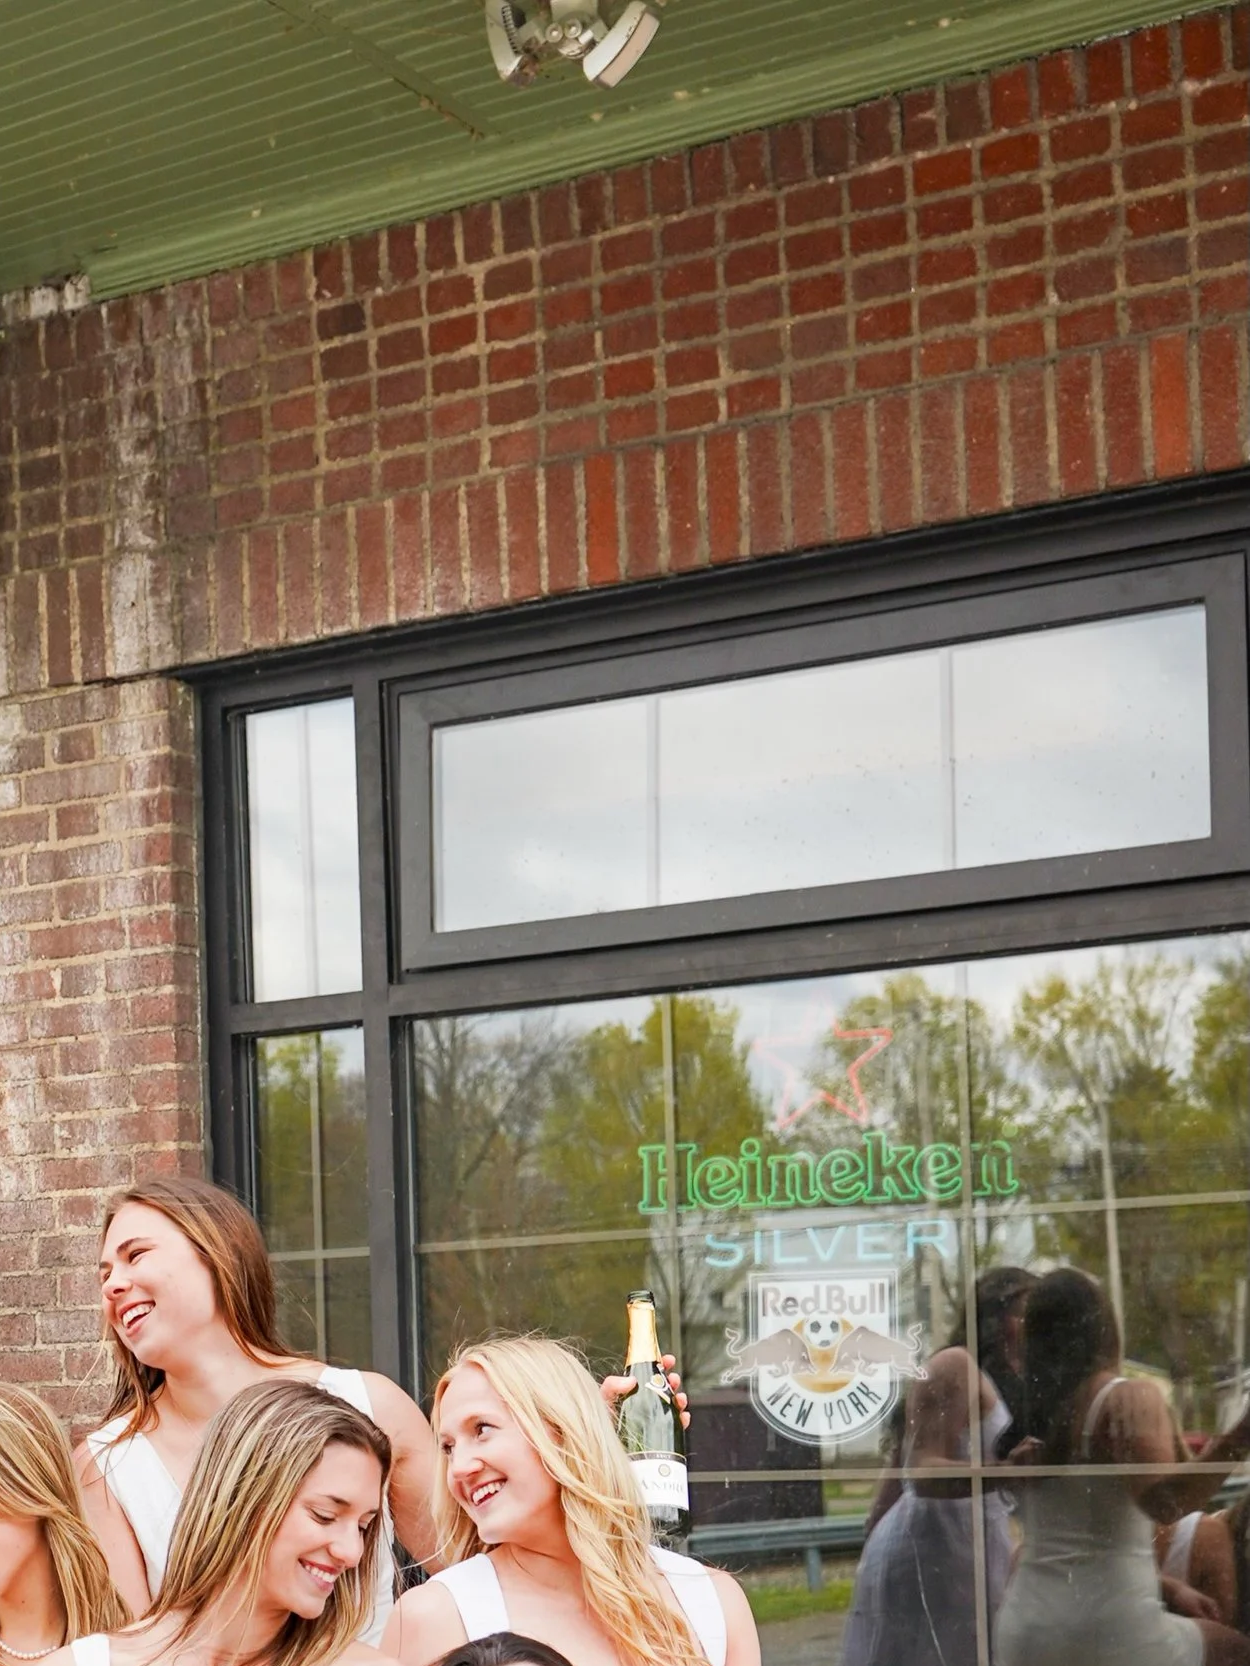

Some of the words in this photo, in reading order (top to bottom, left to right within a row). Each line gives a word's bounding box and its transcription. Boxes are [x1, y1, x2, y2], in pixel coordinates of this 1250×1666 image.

[638, 1131, 1019, 1214] Heineken
[705, 1218, 952, 1268] SILVER
[762, 1285, 821, 1317] Red
[826, 1283, 885, 1315] Bull
[767, 1383, 813, 1428] NEW
[824, 1381, 881, 1429] YORK
